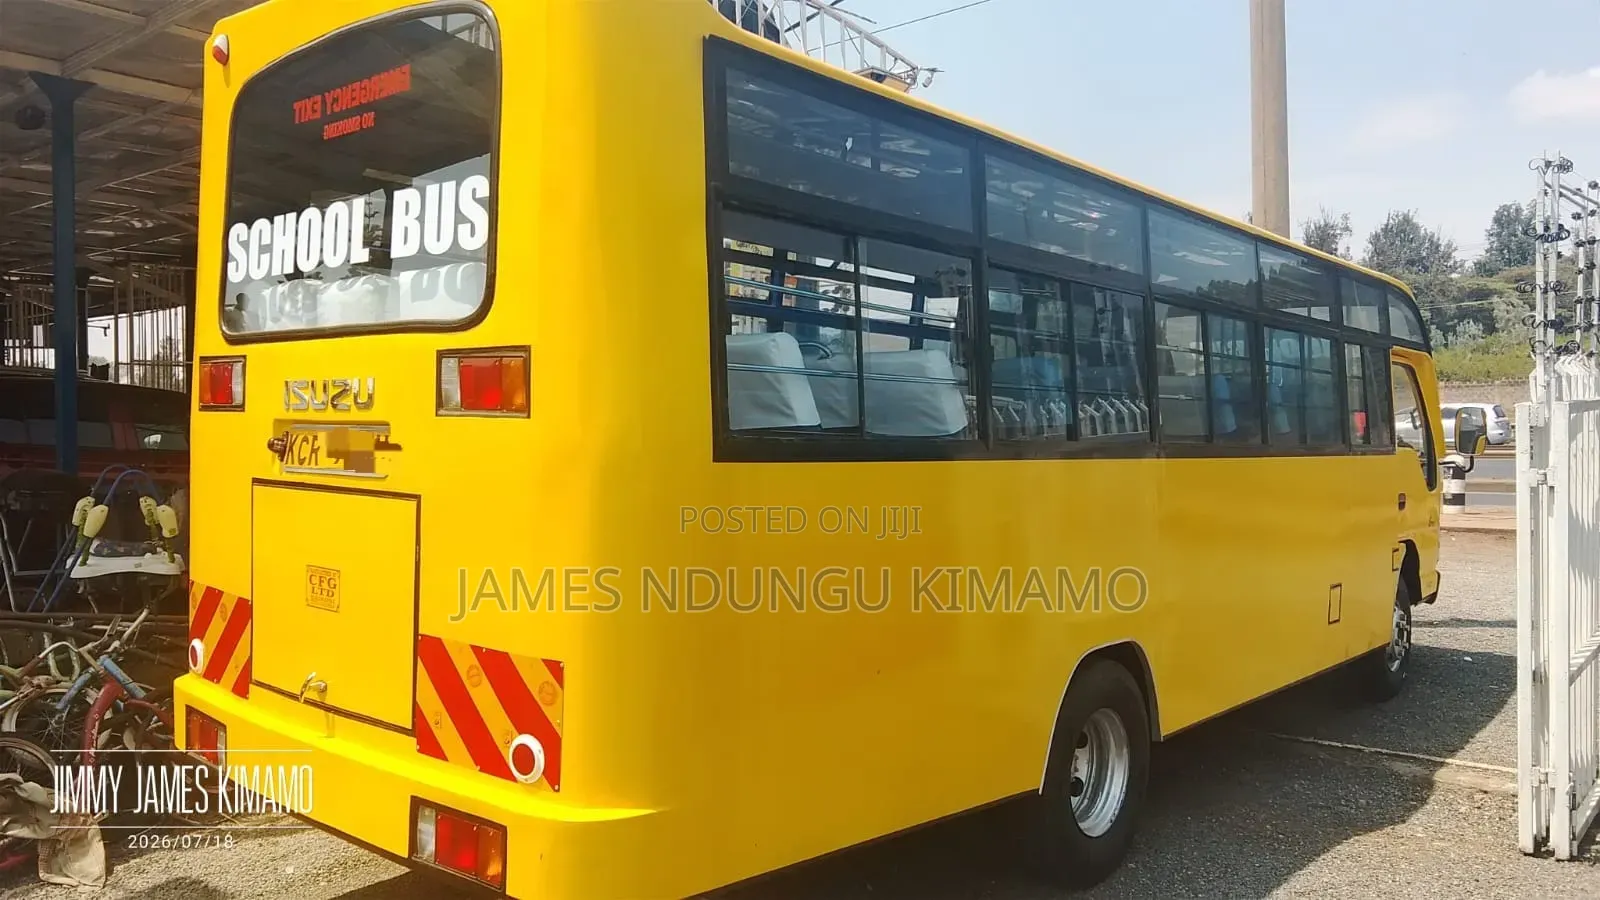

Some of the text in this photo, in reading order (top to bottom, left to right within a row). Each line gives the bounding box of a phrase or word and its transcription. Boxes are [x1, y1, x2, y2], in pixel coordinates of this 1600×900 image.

[227, 174, 490, 284] SCHOOL BUS
[284, 377, 375, 411] ISUZU
[309, 574, 337, 589] CFG
[311, 586, 335, 598] LTD
